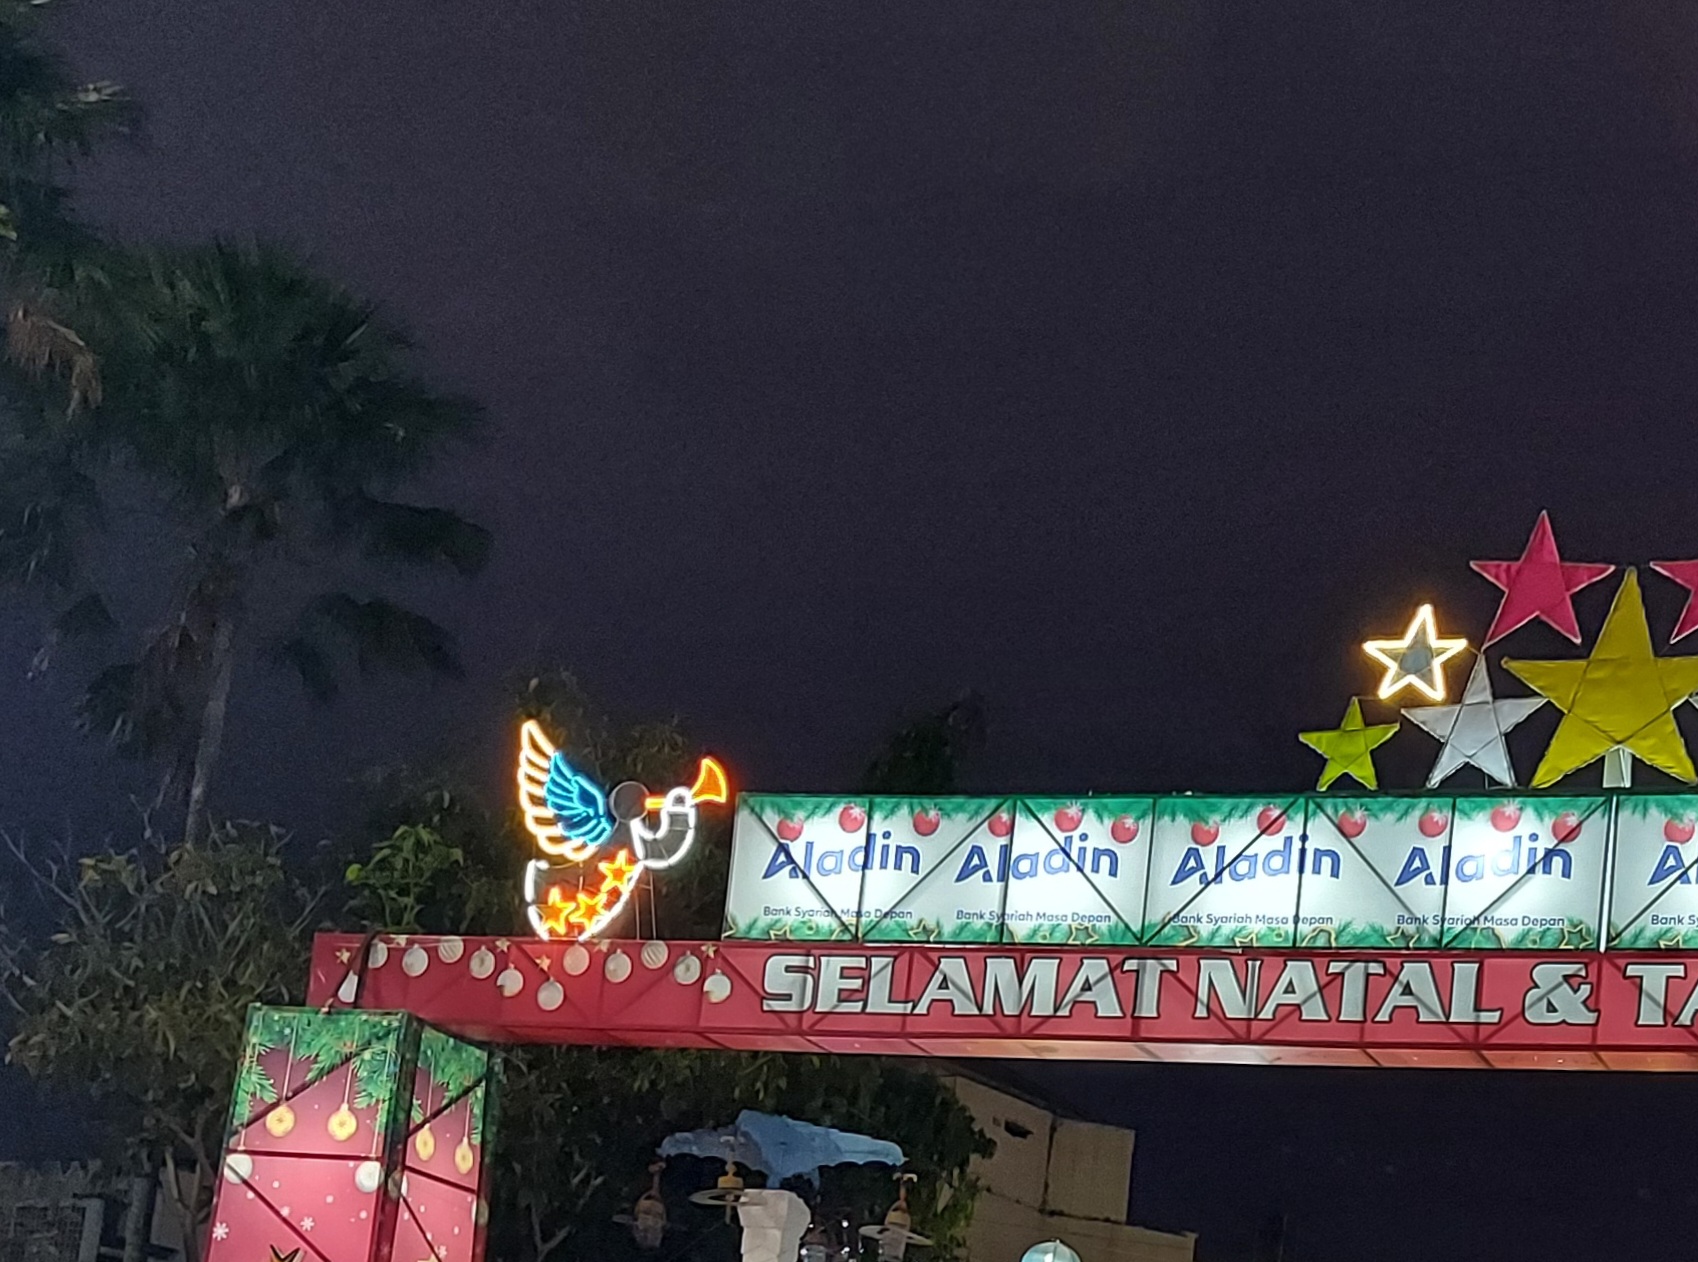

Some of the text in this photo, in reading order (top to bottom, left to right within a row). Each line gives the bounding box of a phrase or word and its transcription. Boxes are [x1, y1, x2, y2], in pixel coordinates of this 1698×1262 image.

[762, 831, 921, 880] Aladin
[954, 832, 1119, 884] Aladin
[1170, 833, 1340, 886] Aladin
[1394, 832, 1572, 887] Aladin
[763, 906, 791, 916] Bank
[956, 910, 1111, 923] Bank Syariah Masa Depan
[1172, 913, 1202, 923] Bank
[1206, 913, 1252, 925] Syariah
[1255, 915, 1288, 924] Masa
[1397, 915, 1428, 925] Bank
[1484, 916, 1518, 926] Masa
[1522, 916, 1564, 928] Depan
[1651, 915, 1684, 925] Bank
[762, 953, 1177, 1019] SELAMAT
[1193, 957, 1501, 1024] NATAL
[1523, 962, 1598, 1025] &
